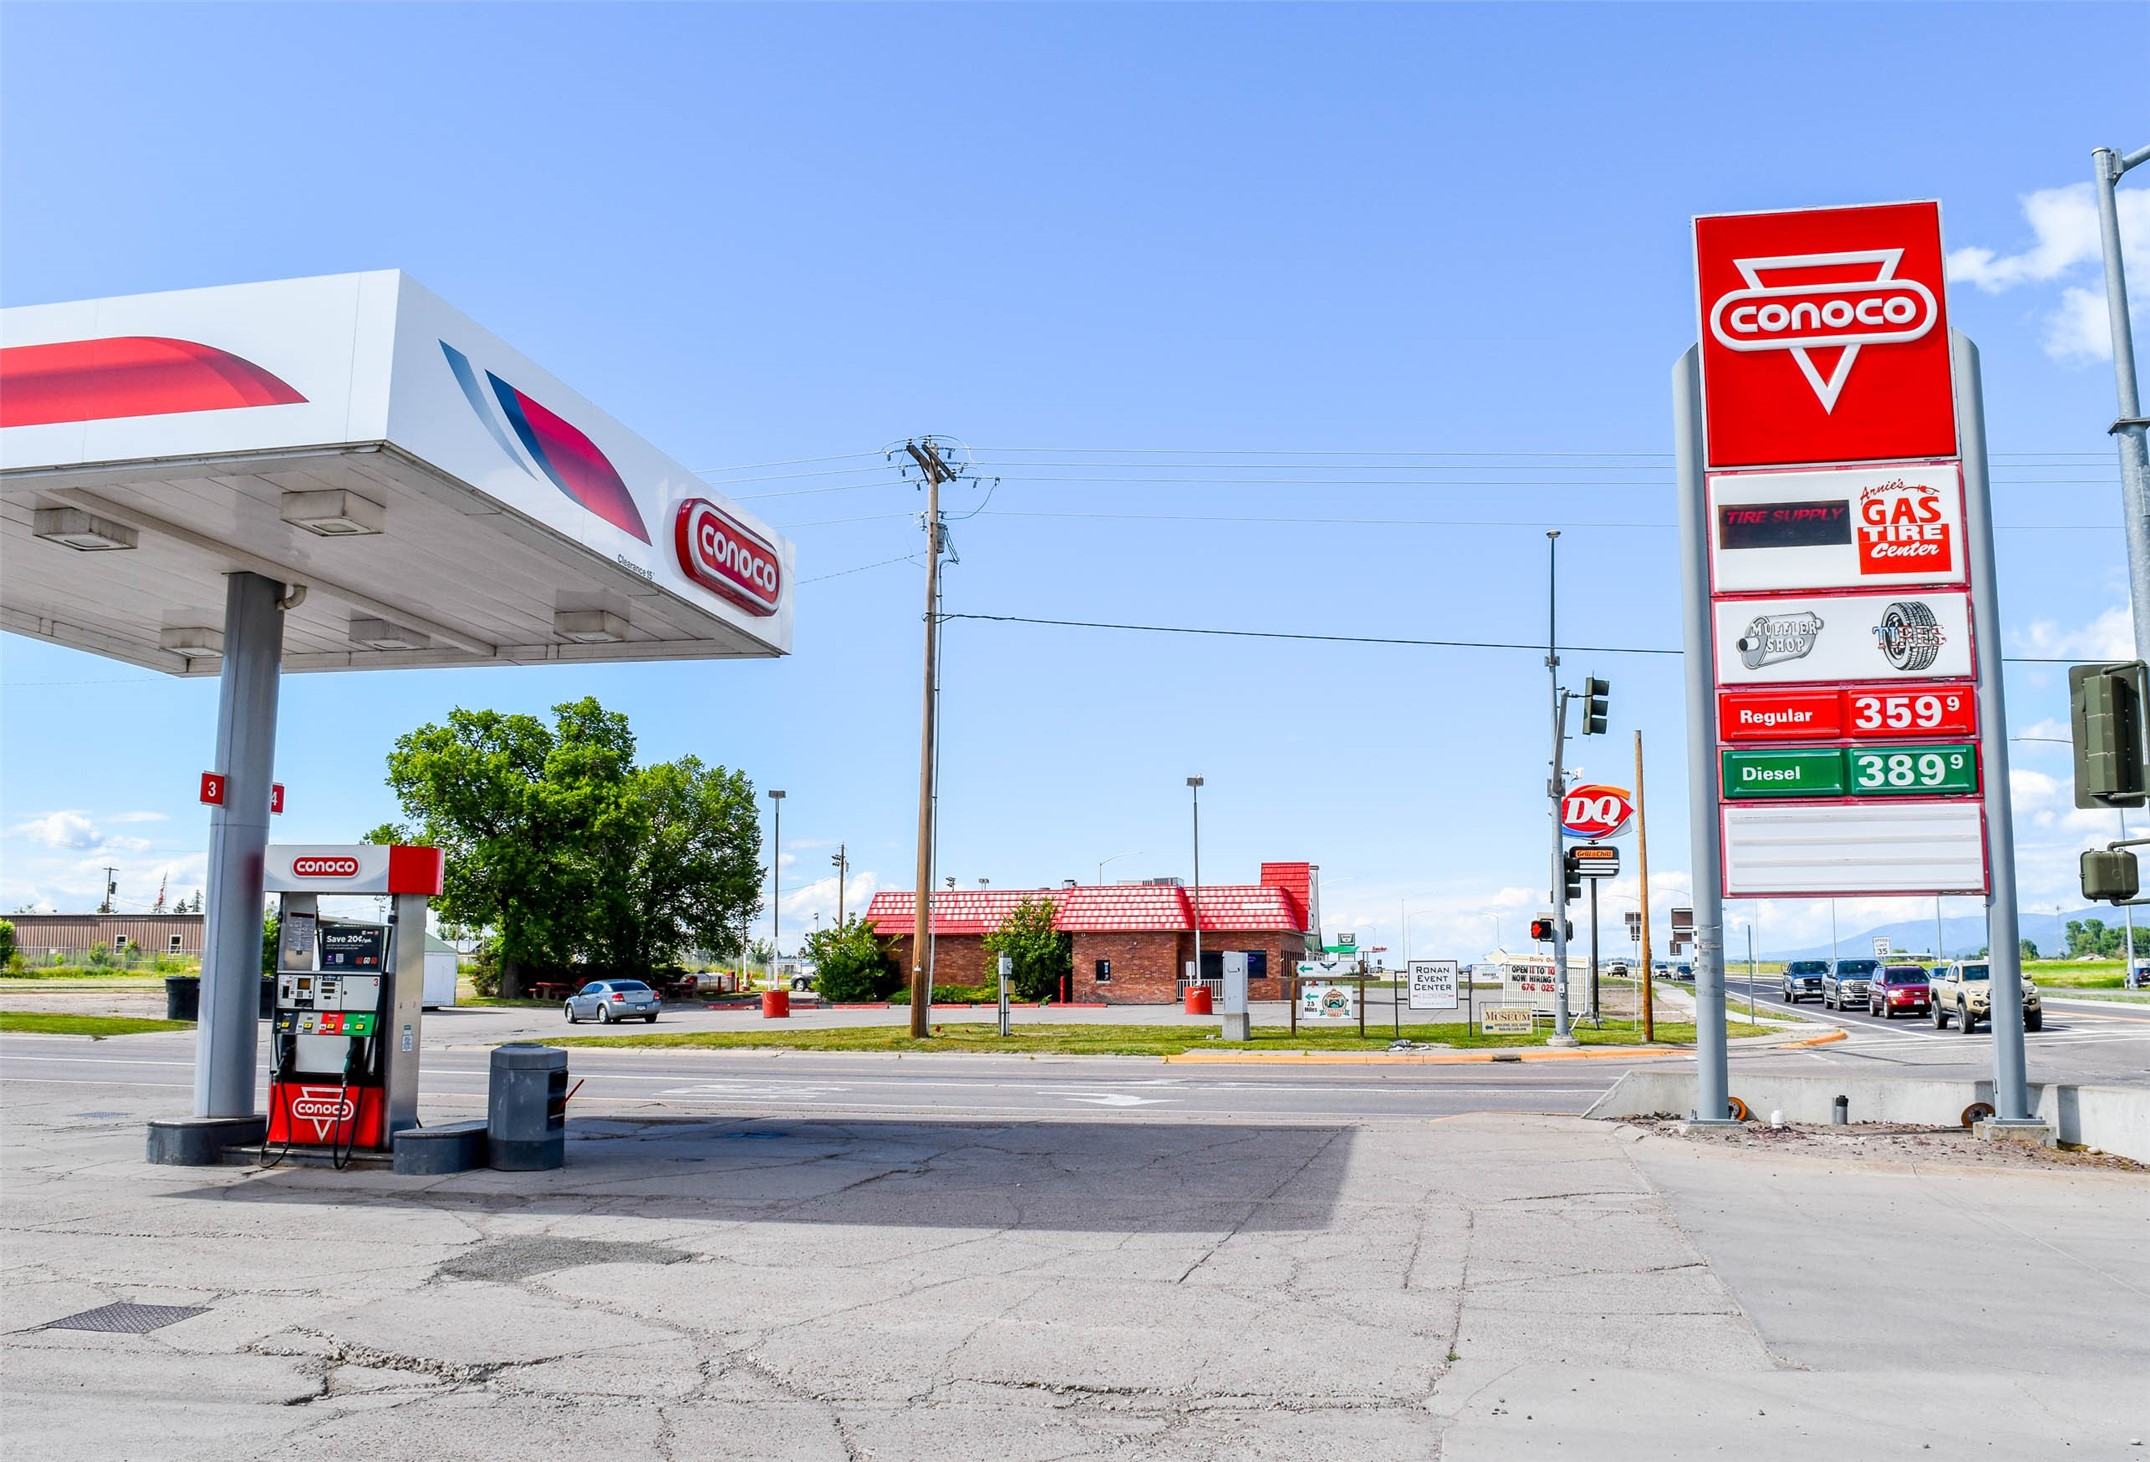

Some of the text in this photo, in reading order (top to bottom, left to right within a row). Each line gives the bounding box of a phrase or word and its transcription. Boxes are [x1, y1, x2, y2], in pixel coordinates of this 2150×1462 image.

[1859, 478, 1906, 505] Arnie's
[1727, 507, 1845, 525] TIRE SUPPLY
[1861, 496, 1942, 526] GAS
[1863, 525, 1944, 542] TIRE
[1870, 542, 1939, 559] Center
[617, 553, 647, 577] Clearance
[1750, 621, 1818, 637] MUFFLER
[1872, 624, 1947, 649] TIRES
[1766, 637, 1805, 653] SHOP
[1740, 708, 1813, 726] Regular
[1742, 766, 1801, 781] Diesel
[208, 781, 216, 797] 3
[271, 791, 278, 806] 4
[1565, 796, 1621, 827] DQ
[326, 935, 346, 943] Save
[1415, 966, 1450, 974] RONAN
[1511, 966, 1528, 974] OPEN
[1536, 966, 1545, 974] TO
[373, 978, 379, 986] 3
[1529, 975, 1552, 983] HIRING
[1521, 983, 1555, 992] 676 025
[1485, 1011, 1530, 1021] MUSEUM
